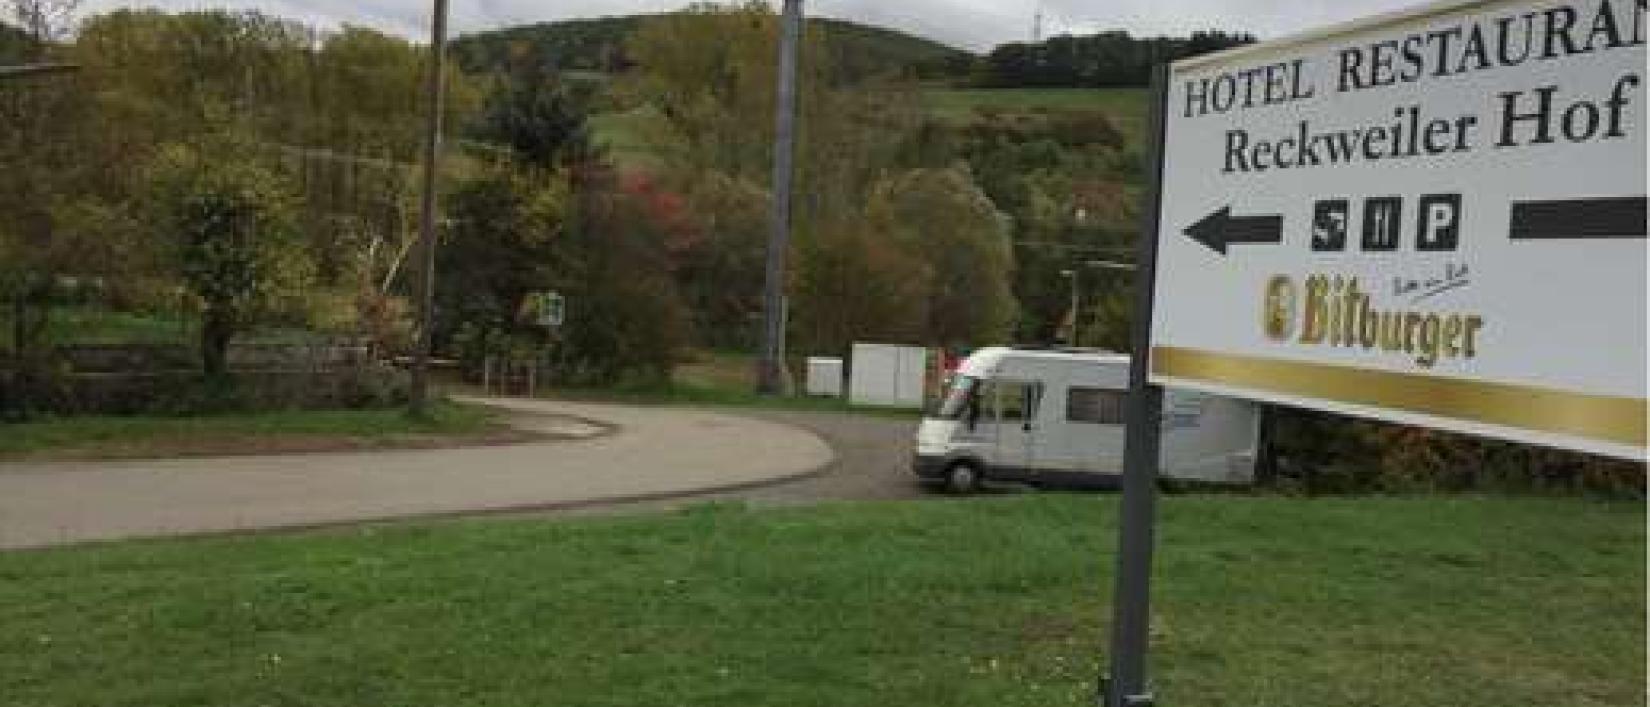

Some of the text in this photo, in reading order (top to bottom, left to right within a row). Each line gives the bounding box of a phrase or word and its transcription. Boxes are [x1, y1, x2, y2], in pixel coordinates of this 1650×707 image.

[1183, 59, 1314, 118] HOTEL
[1221, 74, 1640, 174] Reckweiler Hof
[1299, 273, 1484, 367] Bitburger
